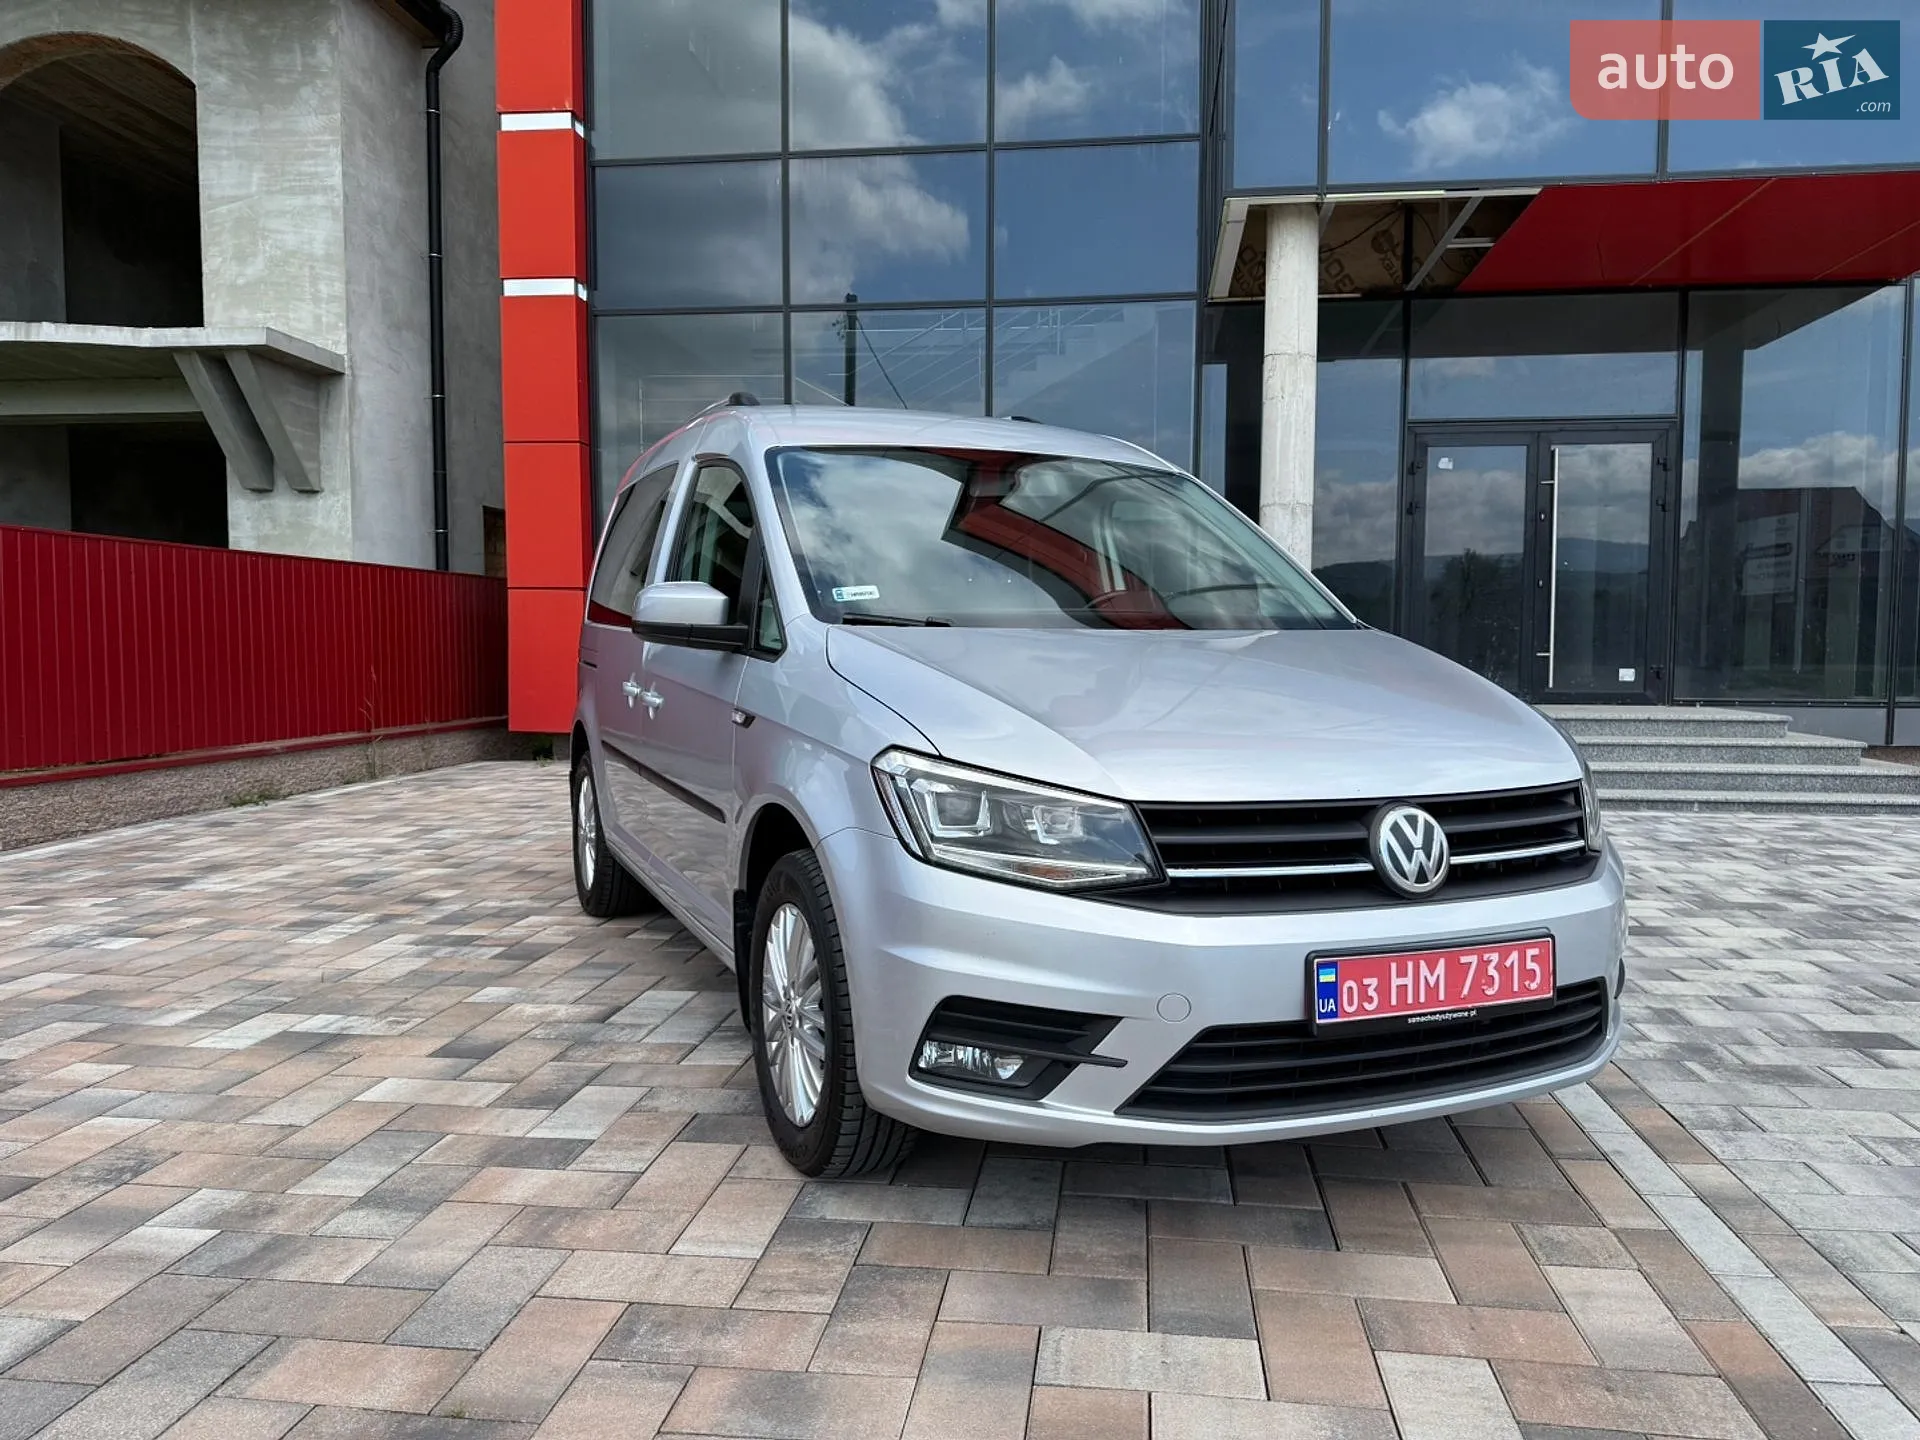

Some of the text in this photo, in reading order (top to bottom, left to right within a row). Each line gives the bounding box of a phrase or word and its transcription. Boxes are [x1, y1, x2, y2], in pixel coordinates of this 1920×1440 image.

[1342, 947, 1541, 1013] 03 HM 7315
[1319, 998, 1336, 1013] UA
